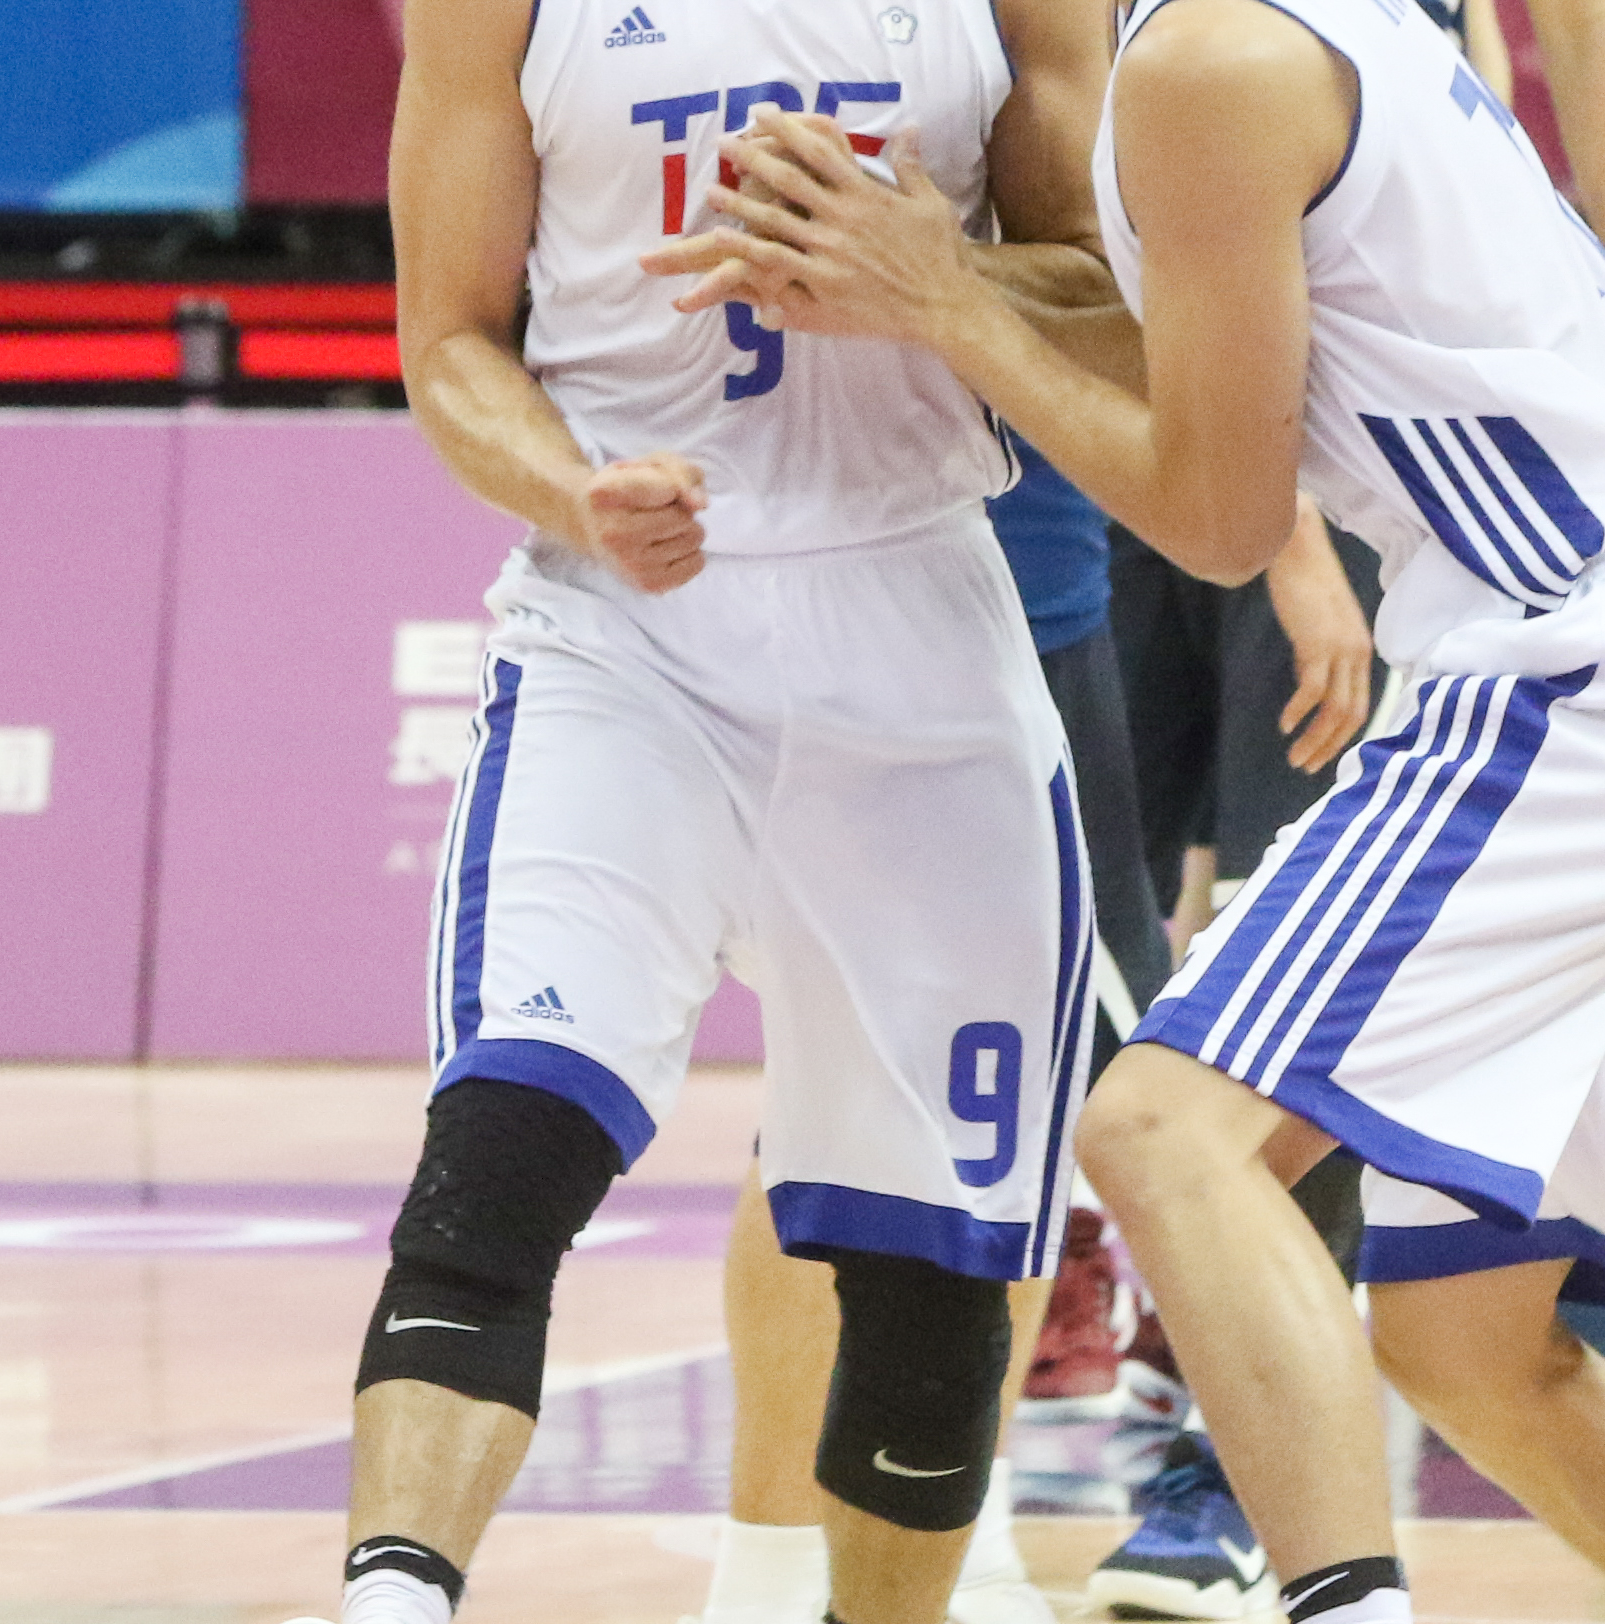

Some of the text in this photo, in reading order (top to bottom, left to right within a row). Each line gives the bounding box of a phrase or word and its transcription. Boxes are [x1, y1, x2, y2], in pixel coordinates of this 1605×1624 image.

[604, 31, 666, 48] adidas
[510, 1004, 574, 1024] adidas
[948, 1021, 1022, 1187] 9
